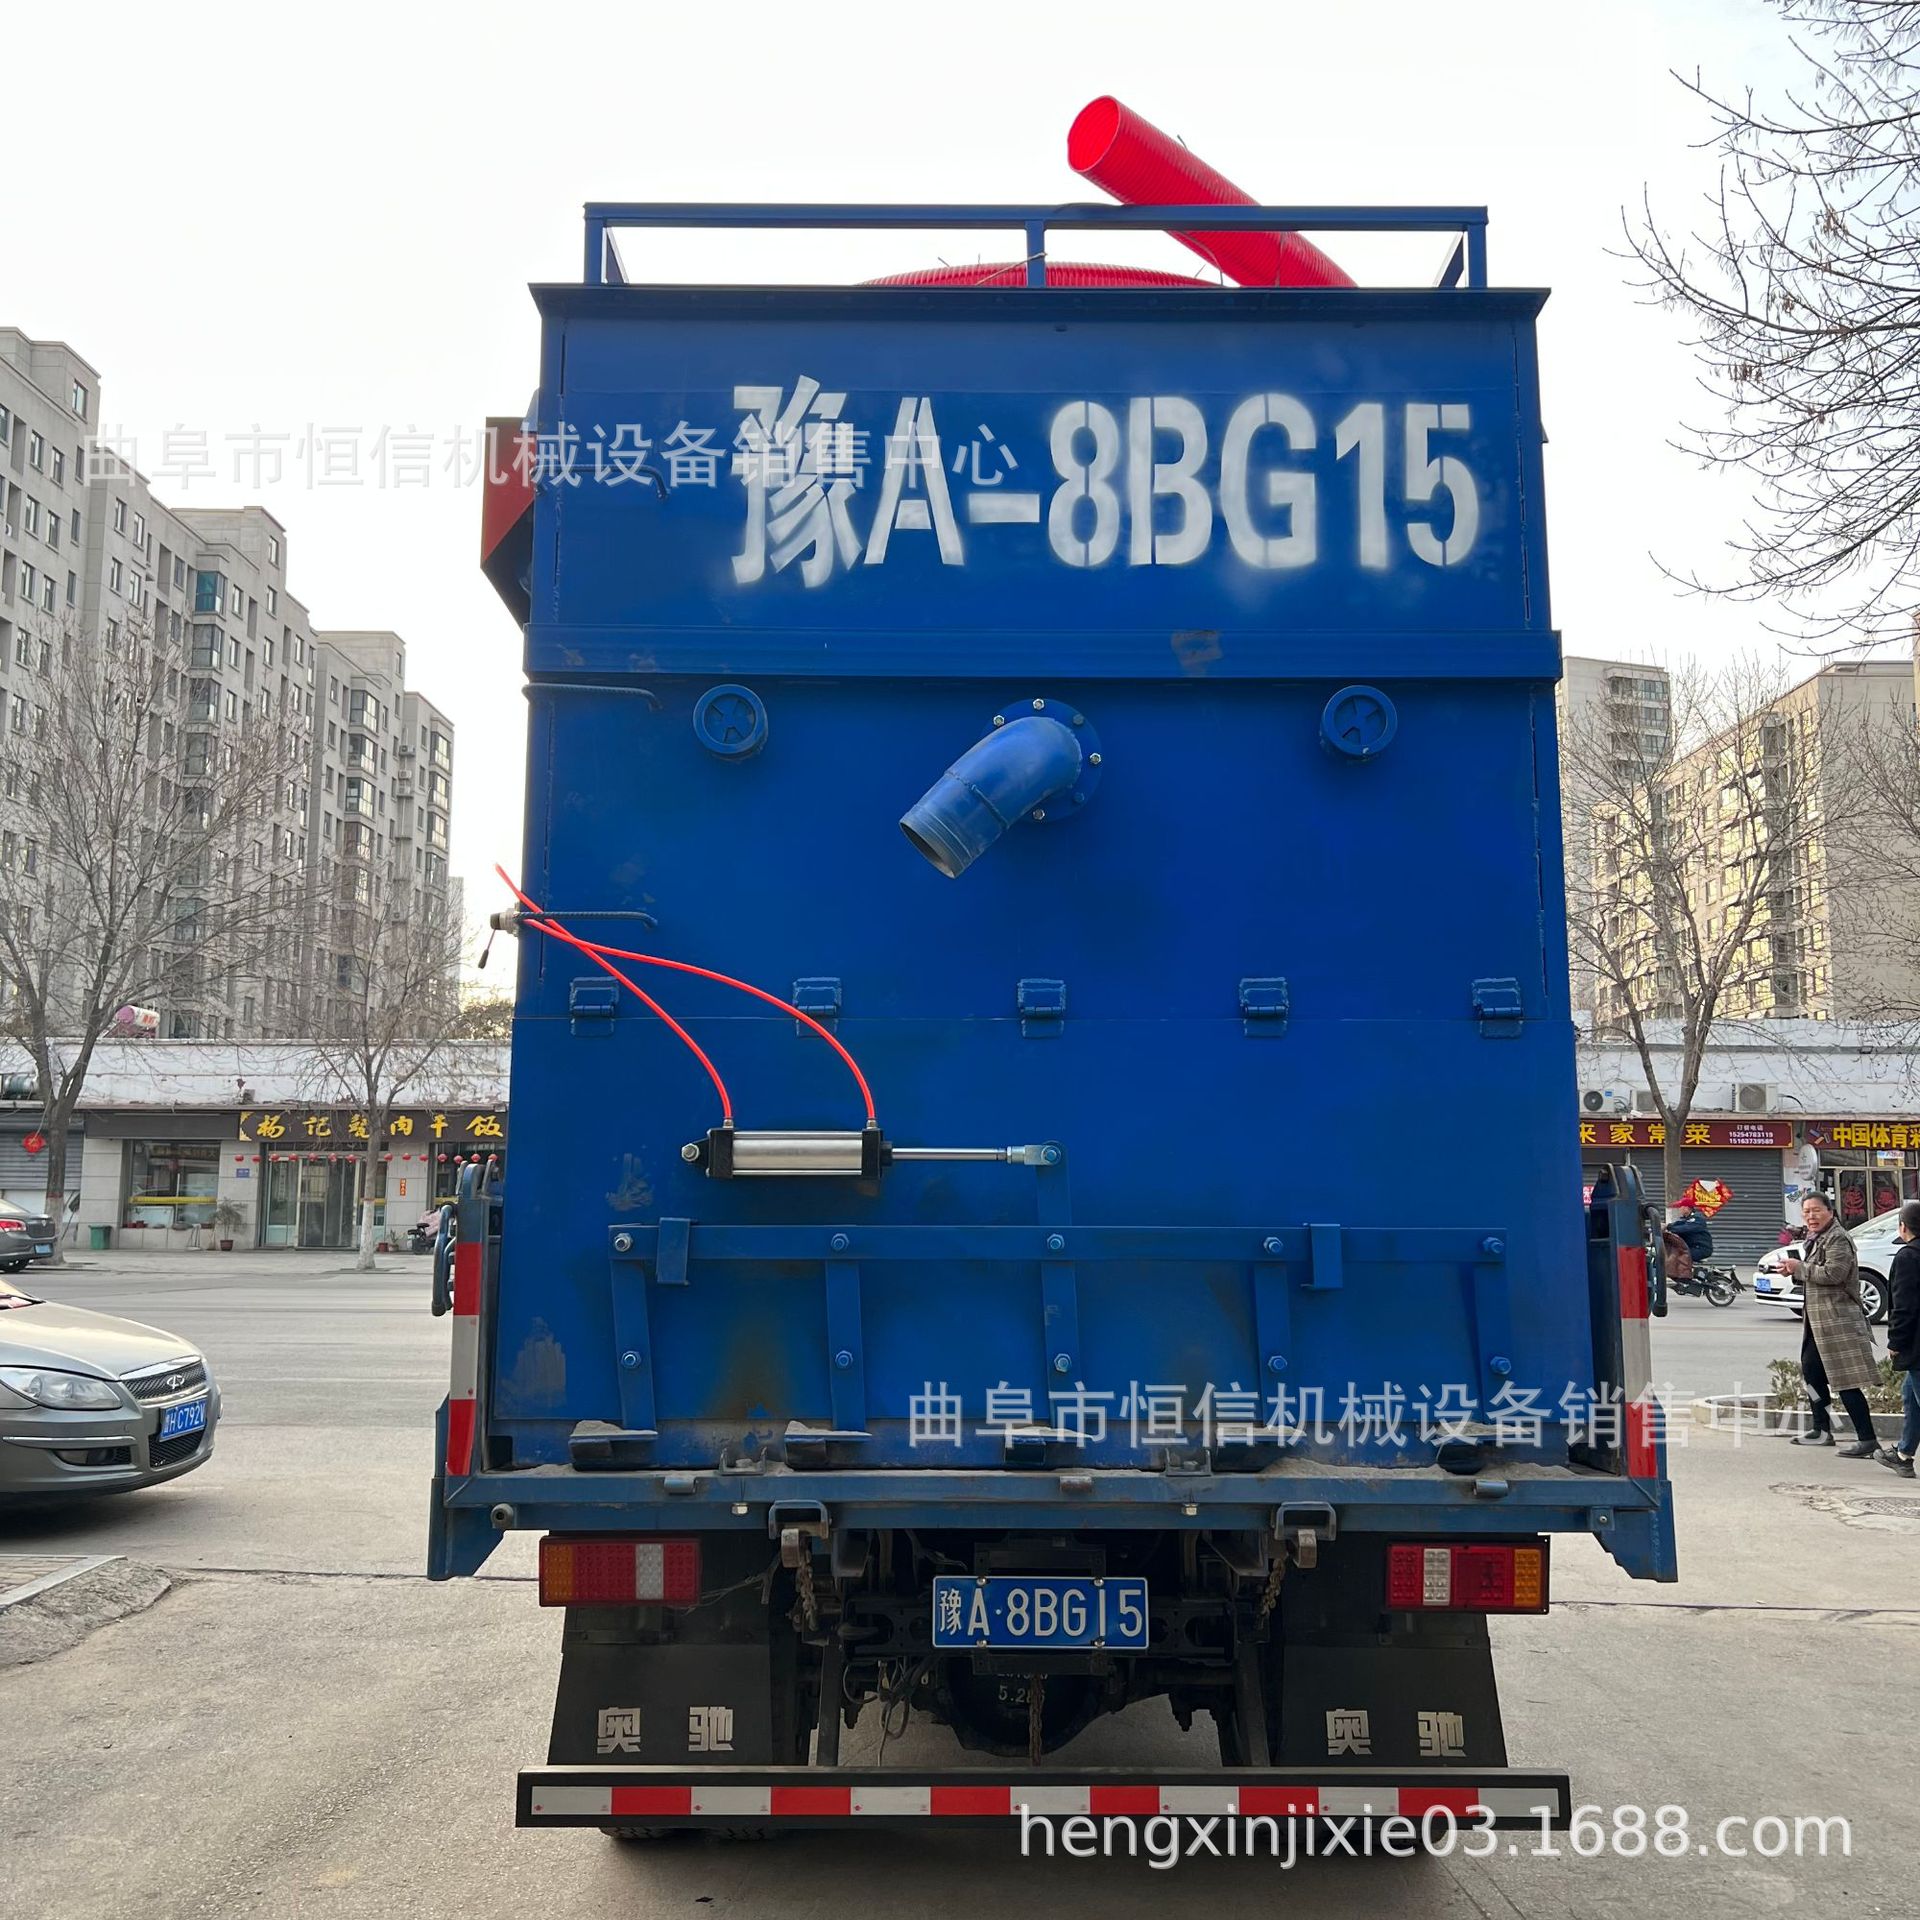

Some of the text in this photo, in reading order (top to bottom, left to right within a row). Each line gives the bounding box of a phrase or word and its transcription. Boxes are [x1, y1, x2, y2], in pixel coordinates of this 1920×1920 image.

[731, 375, 1481, 589] 豫A-8BG15
[597, 1706, 735, 1754] 奥驰
[1326, 1708, 1467, 1757] 奥驰
